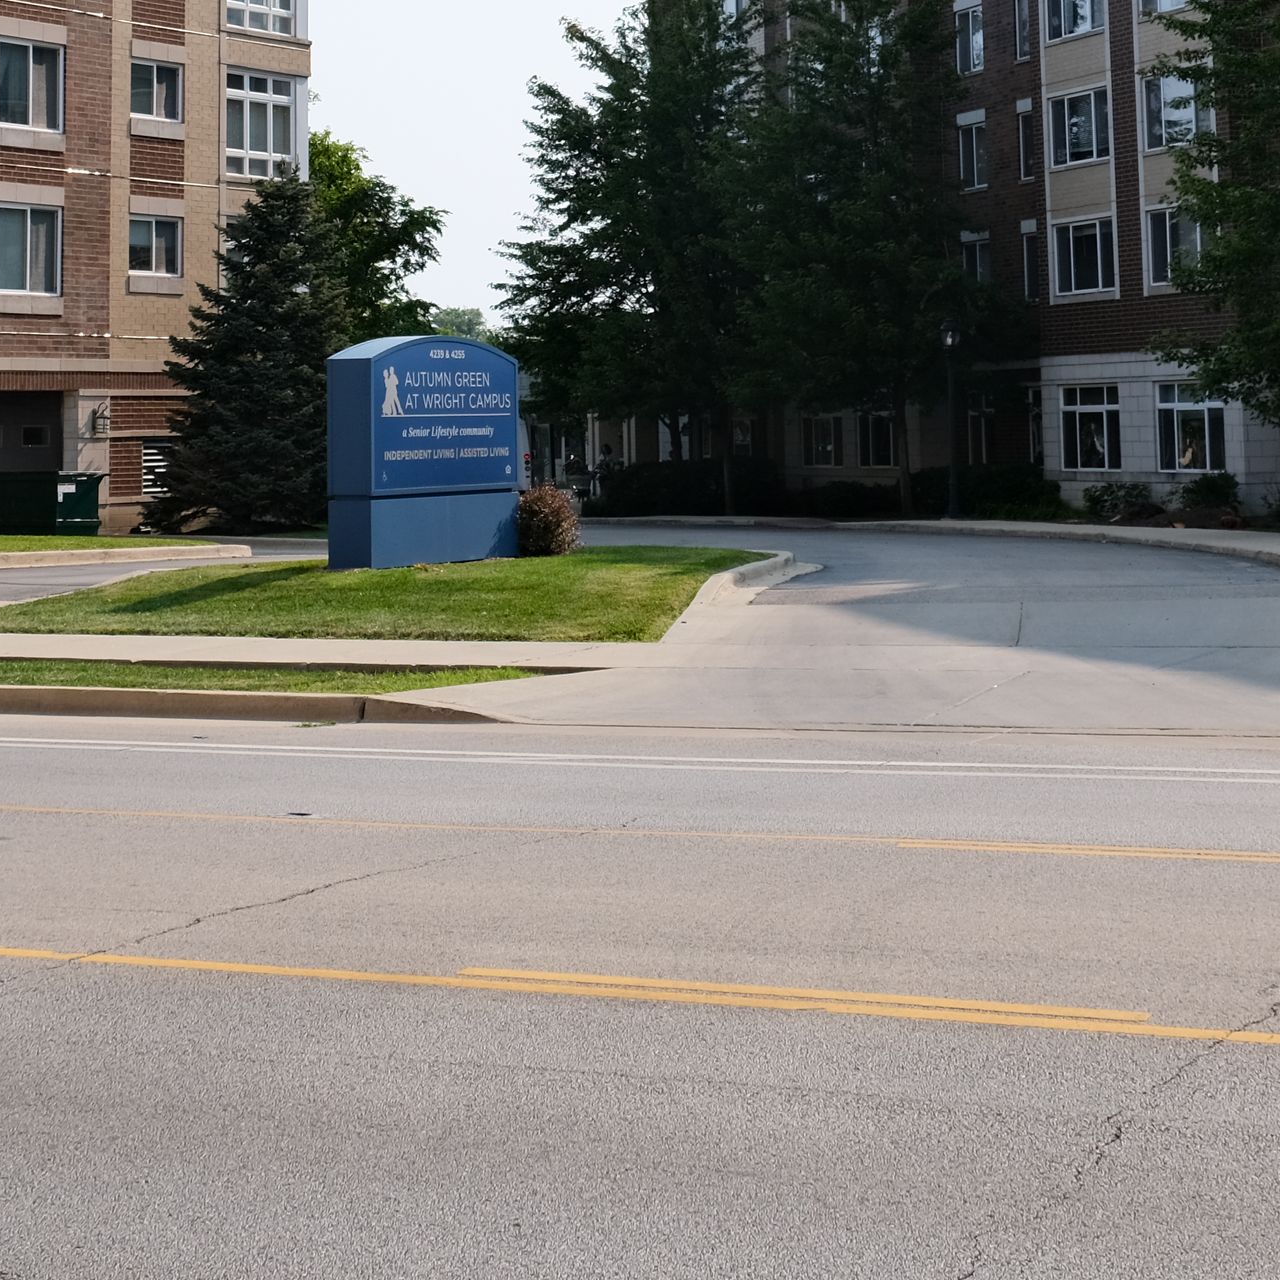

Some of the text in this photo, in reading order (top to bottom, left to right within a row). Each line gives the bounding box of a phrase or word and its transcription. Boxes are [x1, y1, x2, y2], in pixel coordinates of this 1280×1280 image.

[430, 349, 465, 359] 4239 & 4255
[404, 371, 490, 387] AUTUMN GREEN
[405, 393, 511, 409] AT WRIGHT CAMPUS
[402, 425, 494, 439] a Senior Lifestyle community
[384, 447, 509, 461] INDEPENDENT LIVING ASSISTED LIVING
